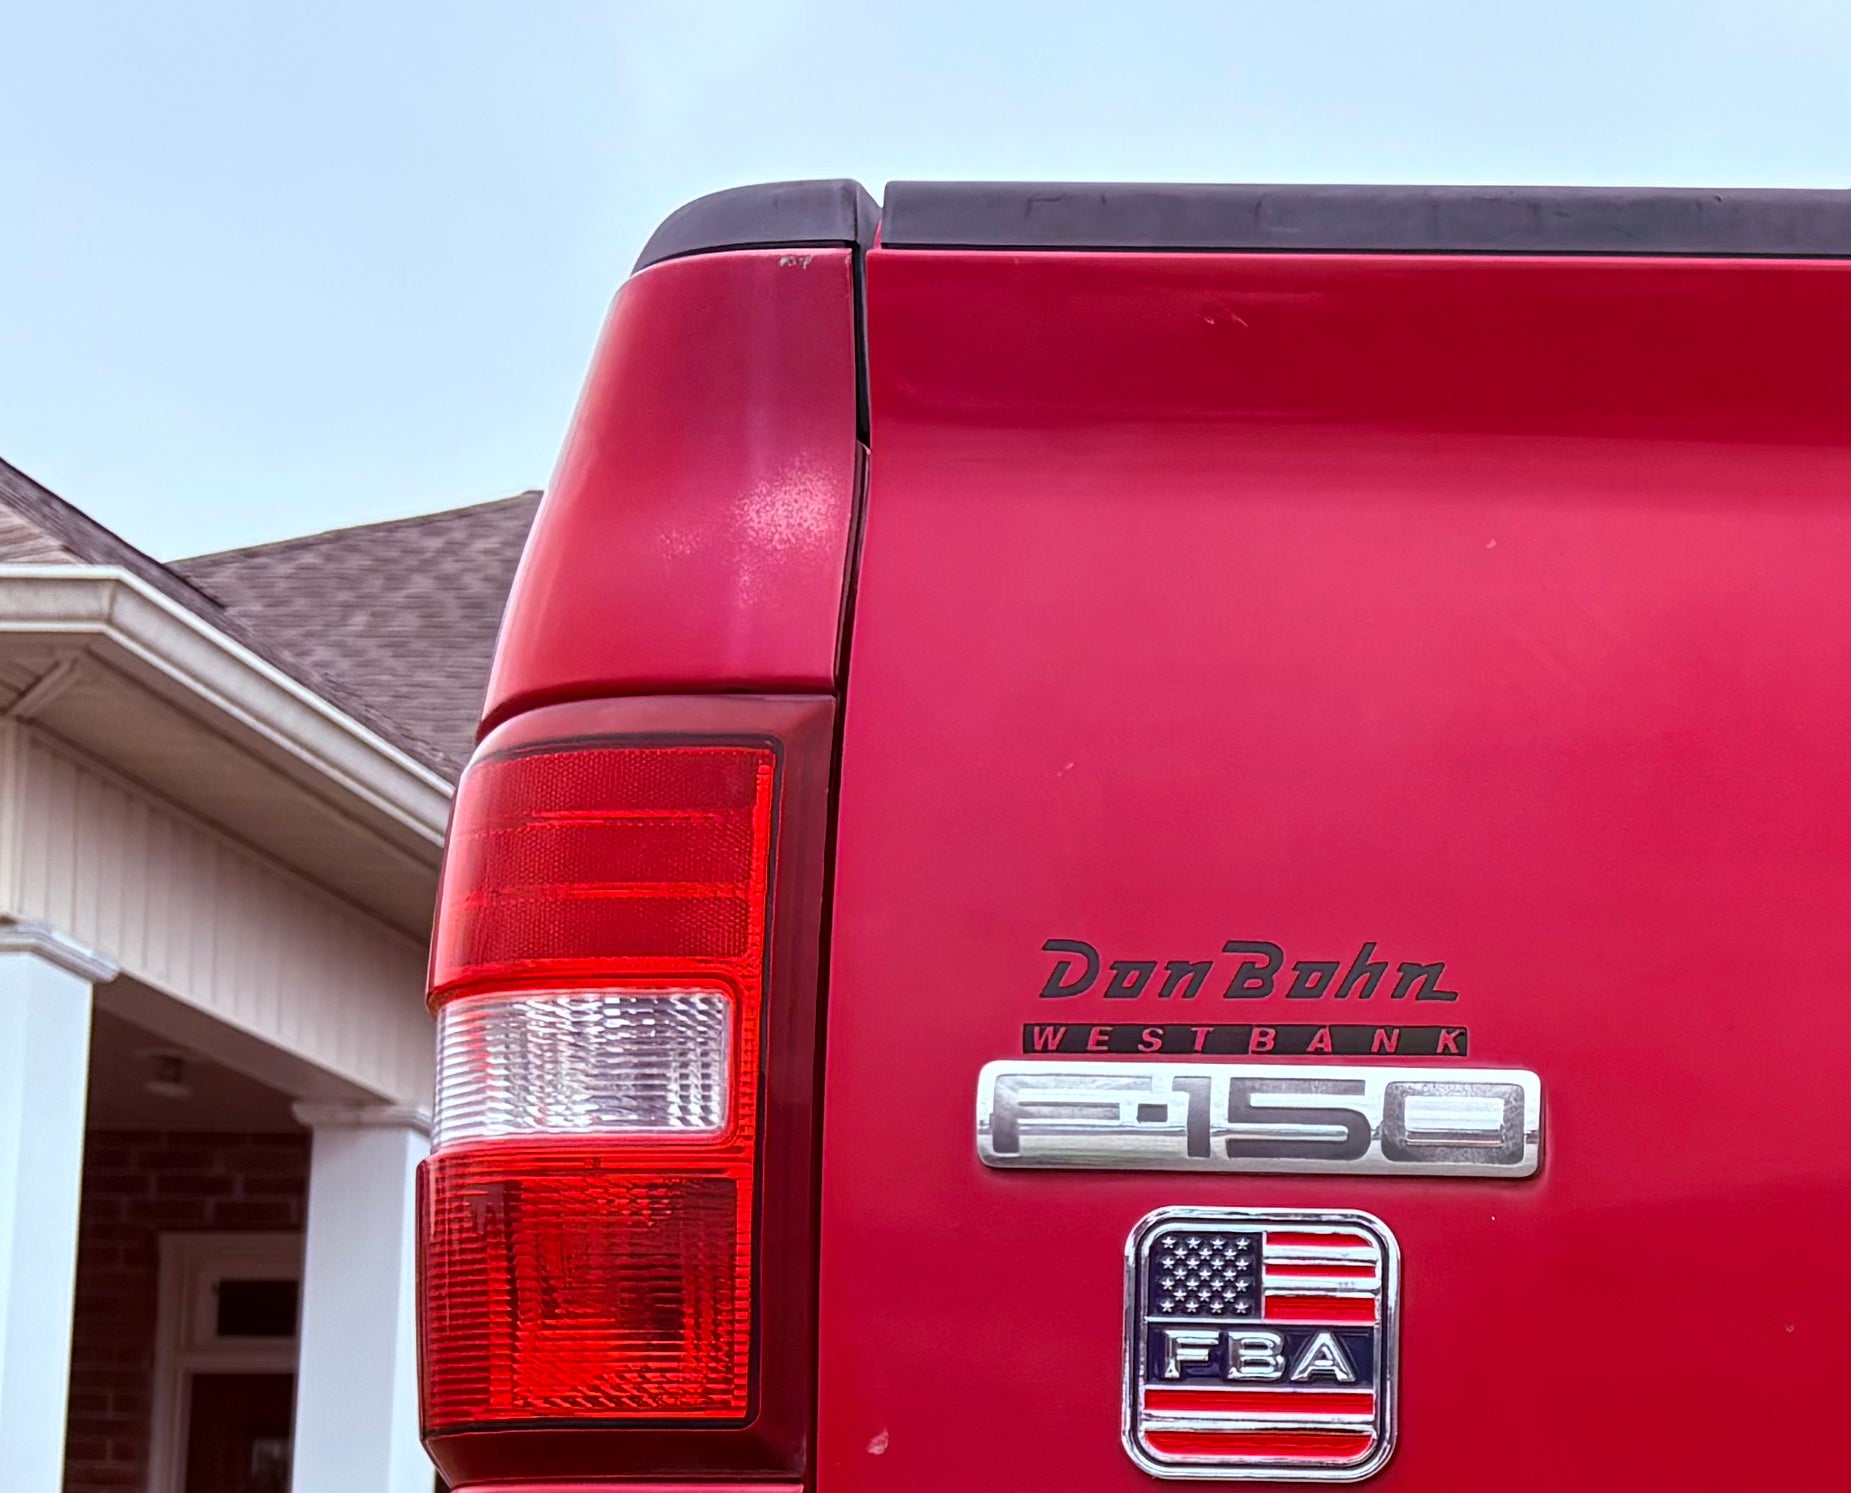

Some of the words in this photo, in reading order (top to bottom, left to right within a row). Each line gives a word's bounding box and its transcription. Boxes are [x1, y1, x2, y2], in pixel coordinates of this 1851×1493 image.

[1039, 938, 1213, 999] Don
[1221, 940, 1459, 1002] Bohn
[1031, 1025, 1465, 1054] WESTBANK
[992, 1073, 1525, 1164] F-150
[1163, 1329, 1358, 1383] FBA
